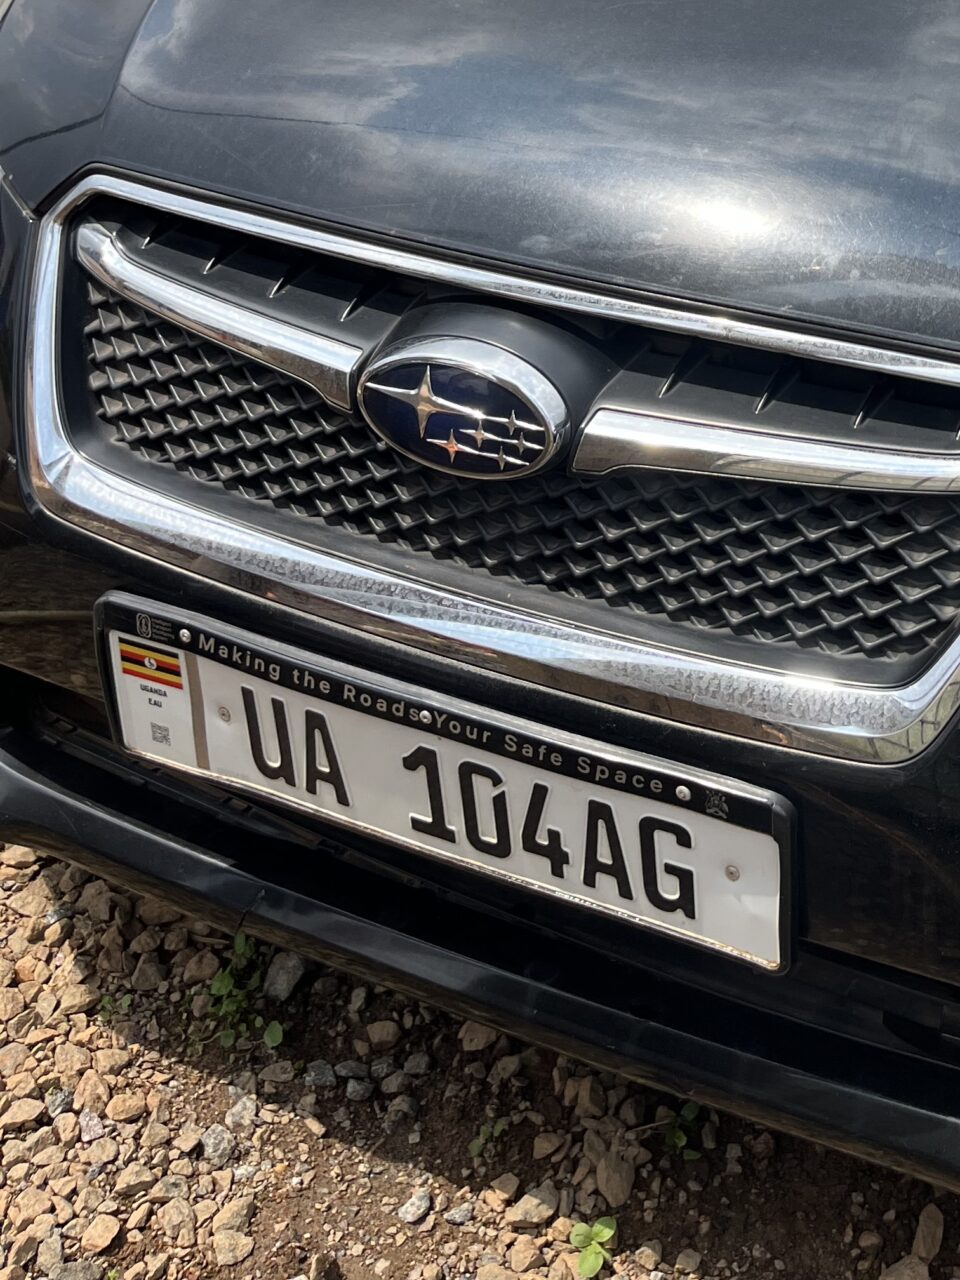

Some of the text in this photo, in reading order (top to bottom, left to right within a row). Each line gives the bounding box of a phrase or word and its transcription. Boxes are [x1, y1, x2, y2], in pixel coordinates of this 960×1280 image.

[140, 683, 167, 697] UGANDA
[198, 633, 663, 793] Making the Roads Your Safe Space
[241, 685, 696, 920] UA 104AG
